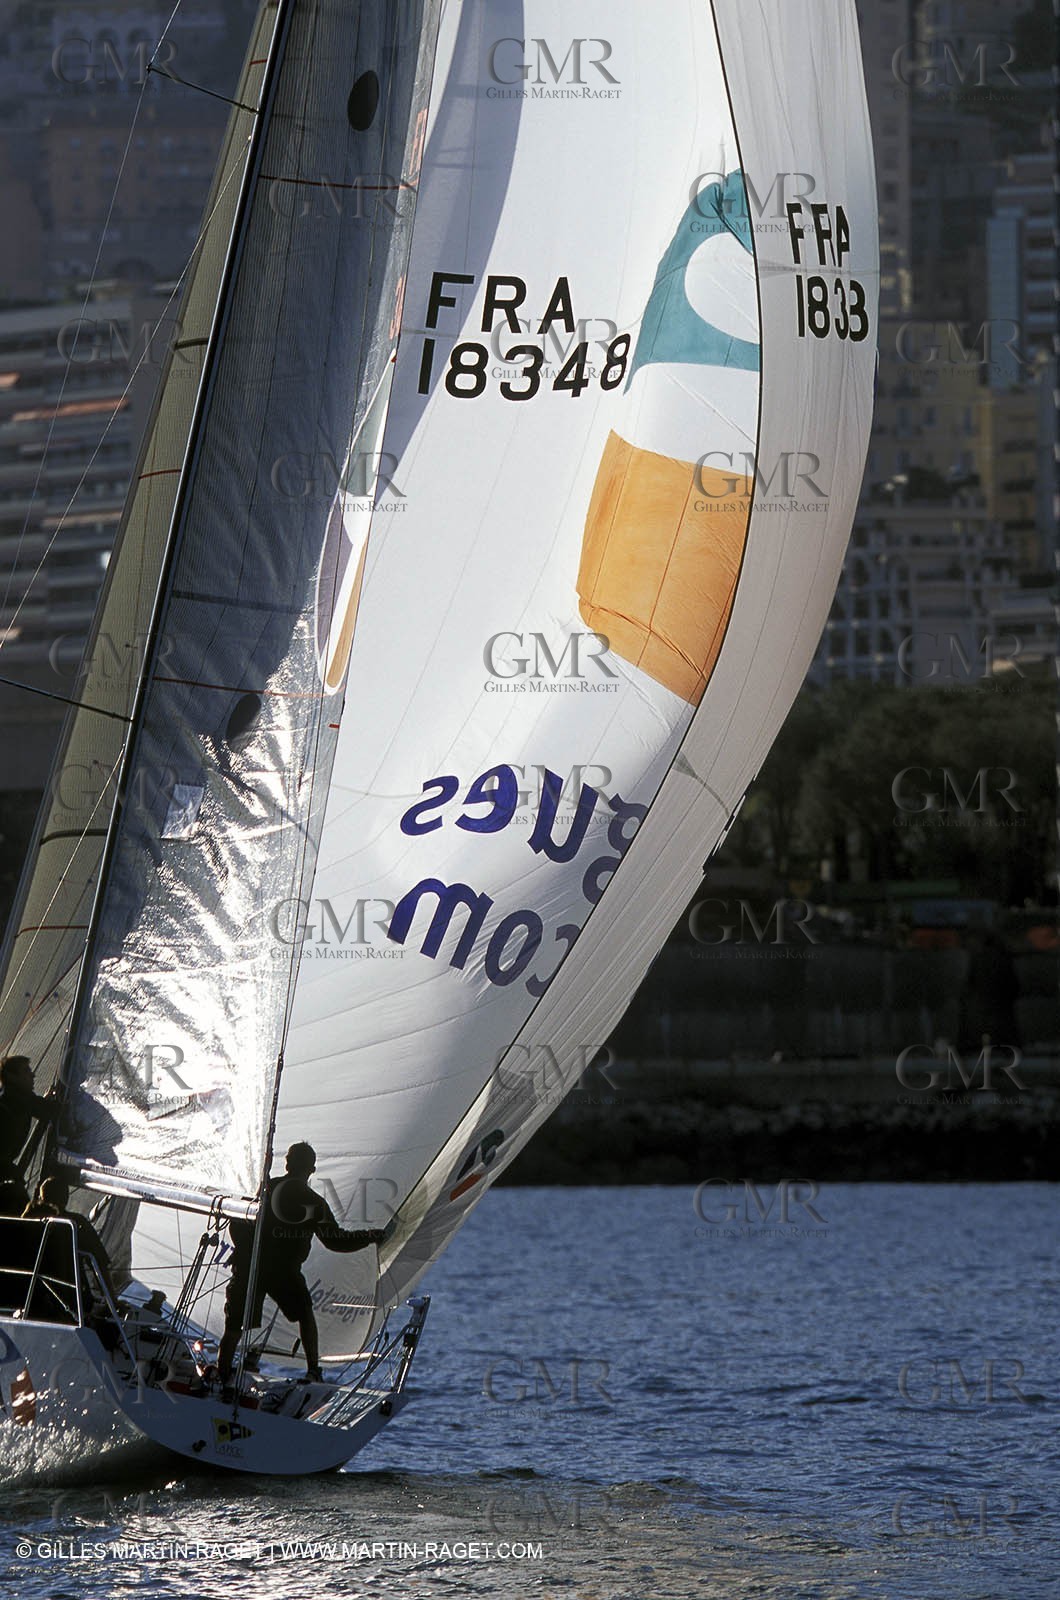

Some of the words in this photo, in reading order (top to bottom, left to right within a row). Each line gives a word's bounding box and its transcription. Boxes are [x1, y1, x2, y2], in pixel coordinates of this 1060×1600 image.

[786, 202, 850, 268] FRA
[425, 271, 576, 334] FRA
[417, 333, 631, 402] 18348
